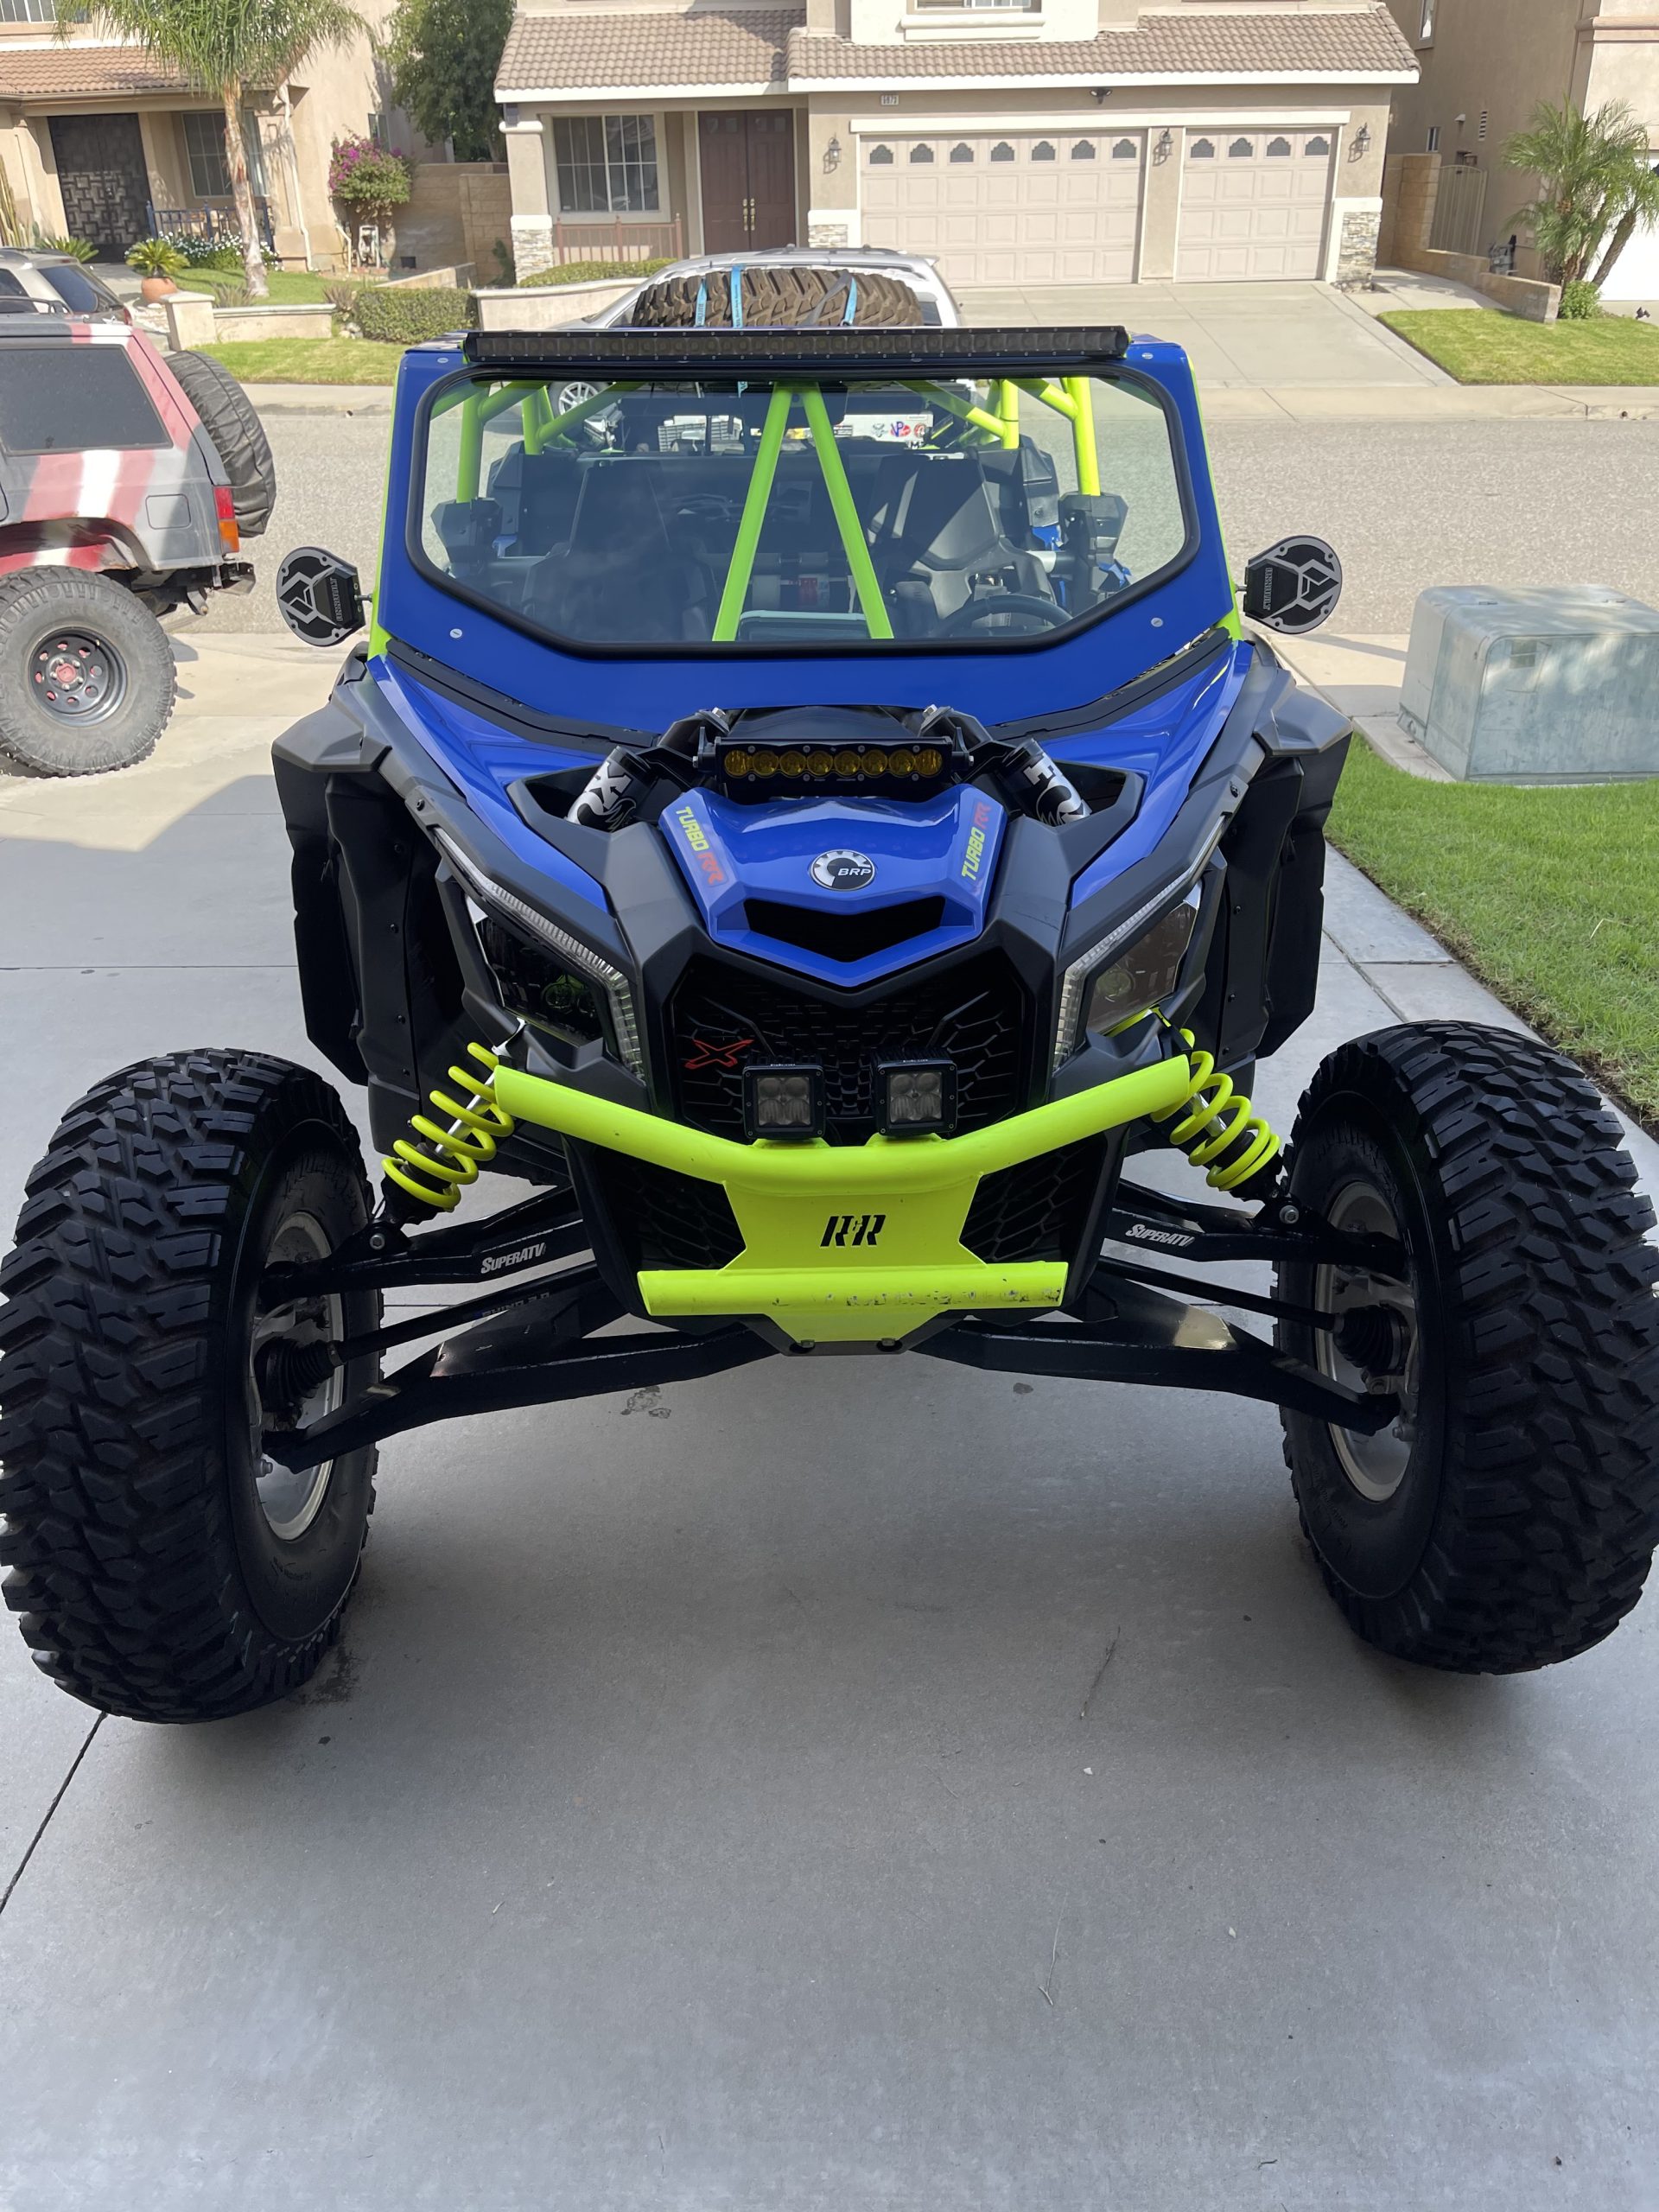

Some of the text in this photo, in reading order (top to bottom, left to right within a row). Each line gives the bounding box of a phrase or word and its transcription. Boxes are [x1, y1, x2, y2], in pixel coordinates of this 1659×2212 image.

[676, 806, 709, 852] TURBO
[837, 868, 872, 876] BRP
[961, 826, 986, 881] TURBO
